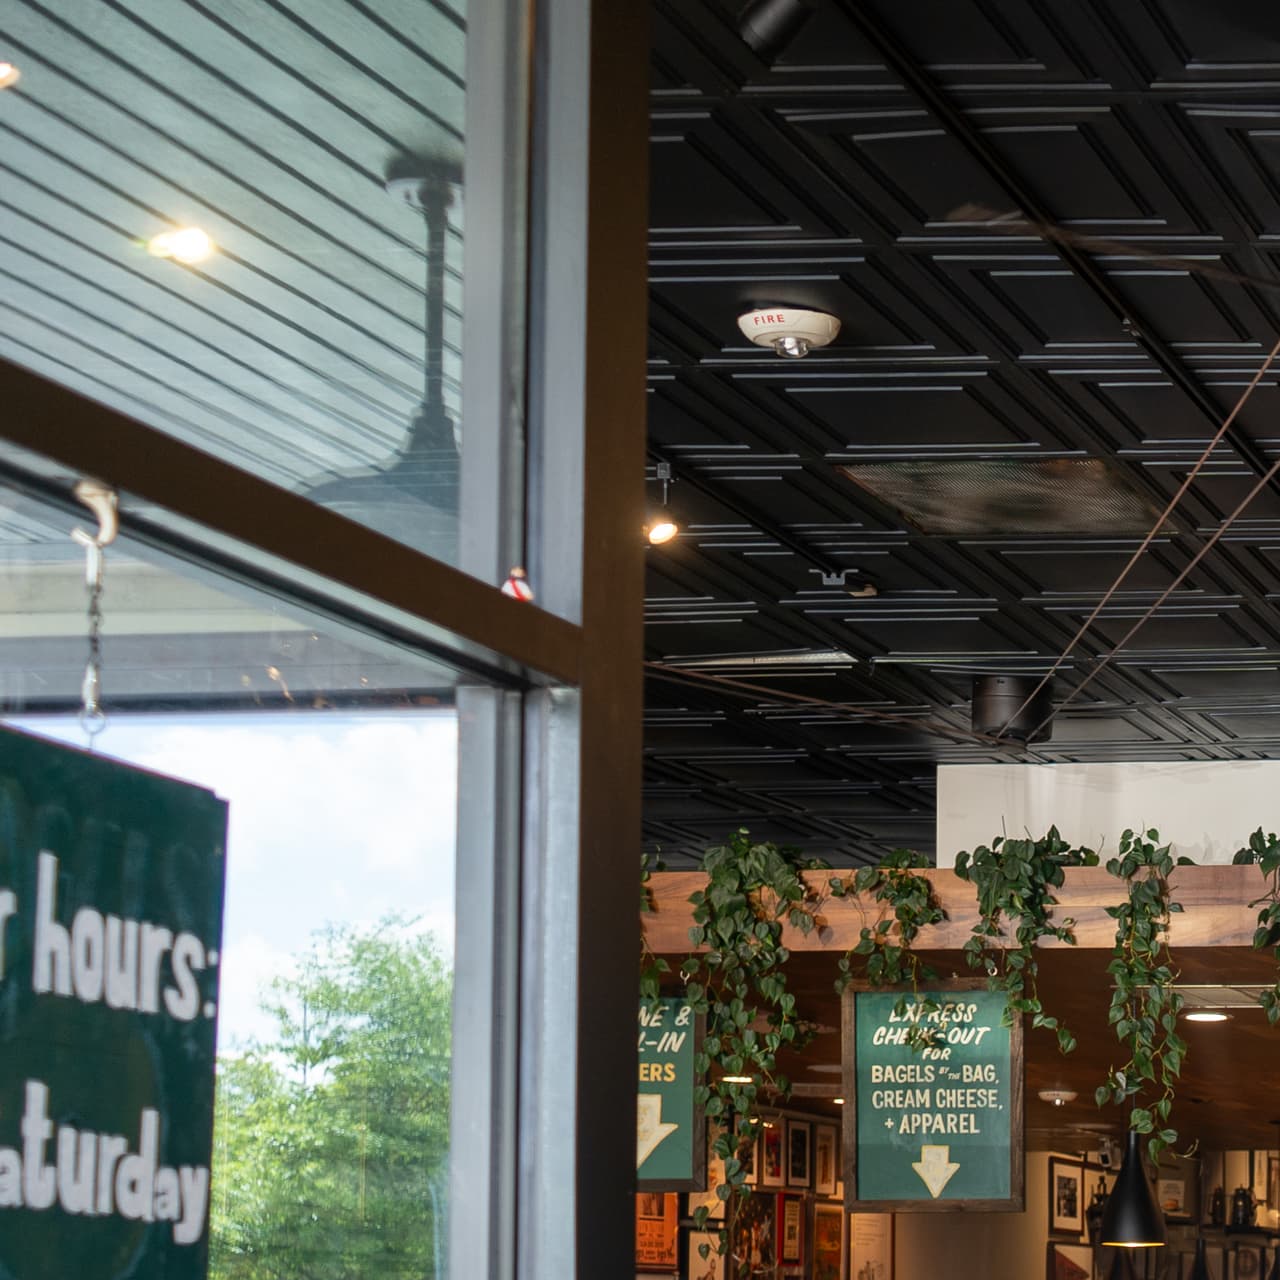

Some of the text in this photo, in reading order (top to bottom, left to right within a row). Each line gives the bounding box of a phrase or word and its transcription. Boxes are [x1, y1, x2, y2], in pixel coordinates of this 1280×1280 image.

[754, 314, 785, 326] FIRE
[33, 849, 219, 1022] hours:
[922, 1048, 951, 1060] FOR
[872, 1065, 935, 1083] BAGELS
[962, 1064, 999, 1084] BAG,
[872, 1088, 1002, 1110] CREAM CHEESE,
[899, 1114, 980, 1134] APPAREL
